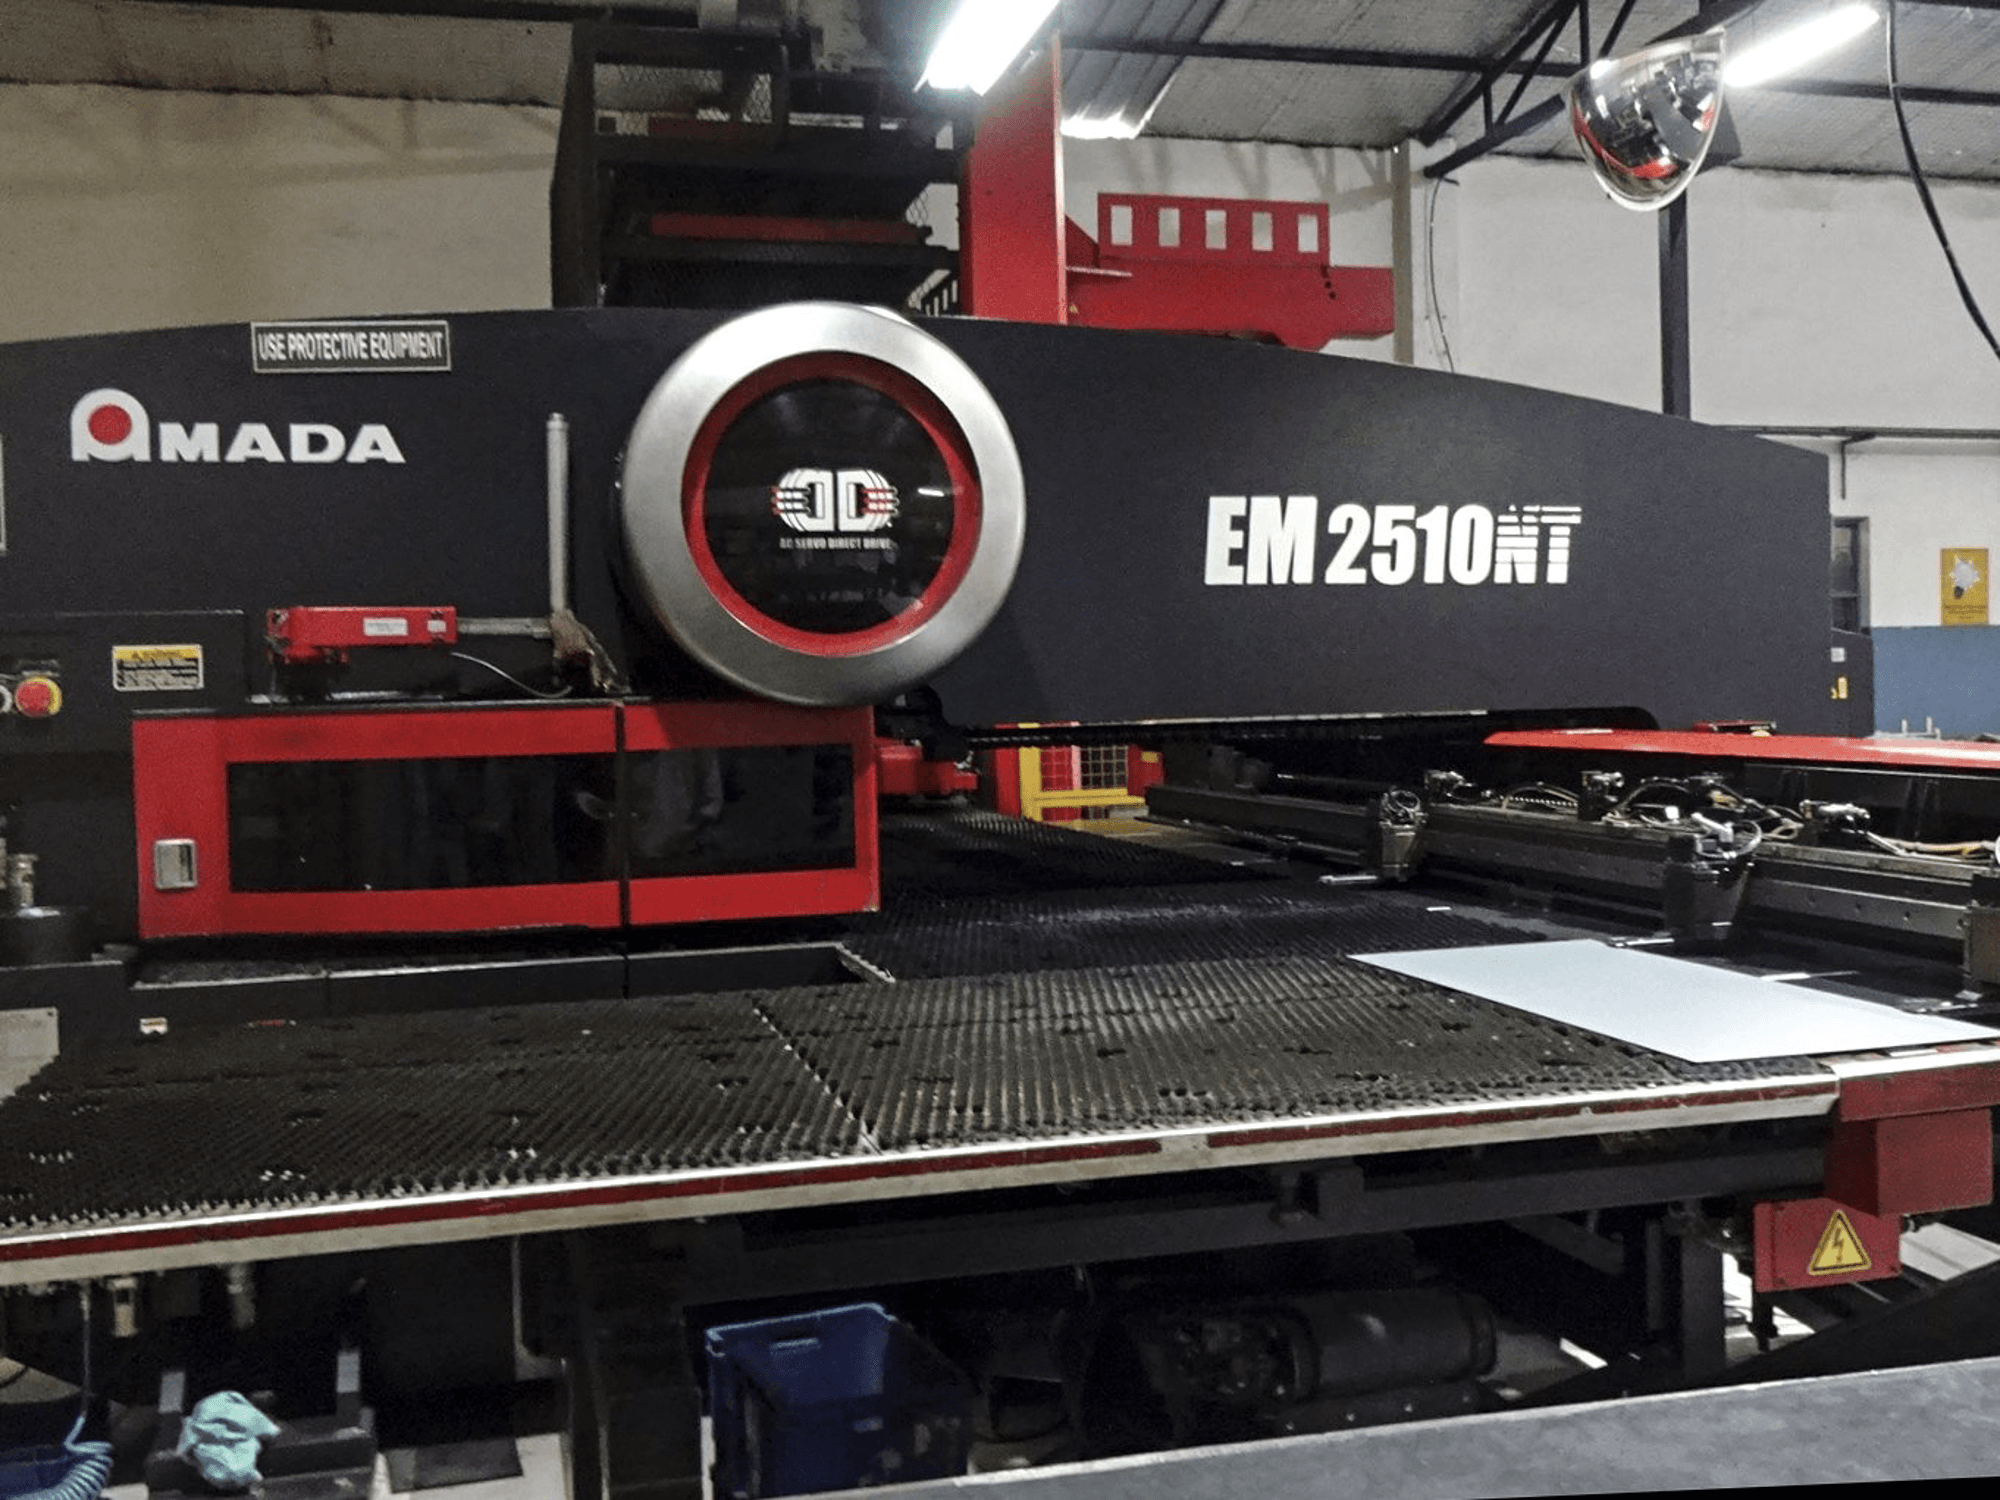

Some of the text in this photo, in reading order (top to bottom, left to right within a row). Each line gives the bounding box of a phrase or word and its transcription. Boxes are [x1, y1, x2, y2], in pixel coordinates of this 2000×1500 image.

[258, 331, 443, 360] USE PROTECTIVE EQUIPMENT
[70, 388, 407, 463] AMADA
[1204, 495, 1319, 585] EM
